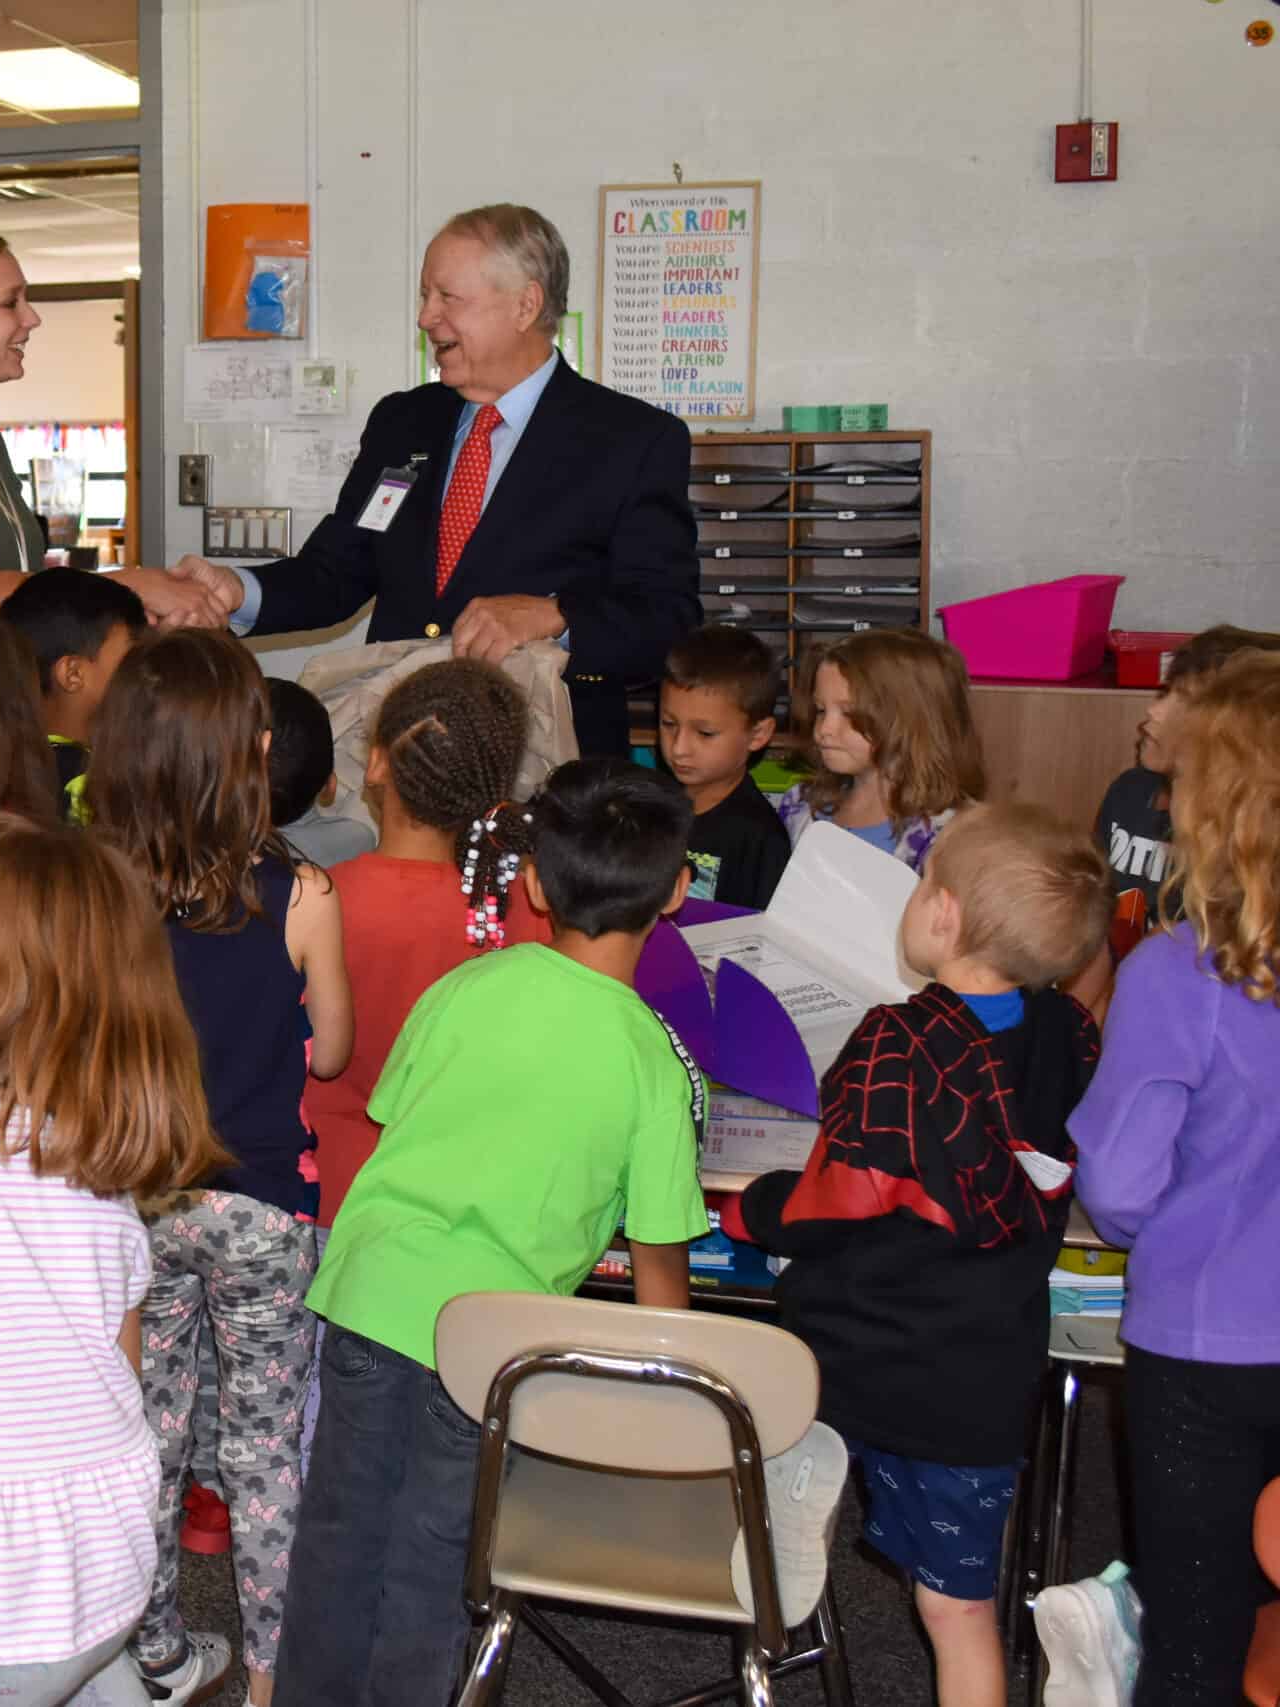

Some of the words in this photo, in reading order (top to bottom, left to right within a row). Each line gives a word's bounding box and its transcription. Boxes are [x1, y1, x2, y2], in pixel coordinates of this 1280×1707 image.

[614, 208, 747, 235] CLASSROOM
[665, 239, 737, 254] SCIENTISTS
[665, 254, 726, 268] AUTHORS
[663, 267, 740, 281] IMPORTANT
[663, 281, 723, 296] LEADERS
[662, 310, 726, 323] READERS
[664, 325, 729, 338] THINKERS
[662, 339, 729, 353] CREATORS
[662, 354, 673, 367] A
[678, 353, 725, 367] FRIEND
[661, 367, 699, 380] LOVED
[663, 382, 683, 395] THE
[689, 381, 744, 395] REASON
